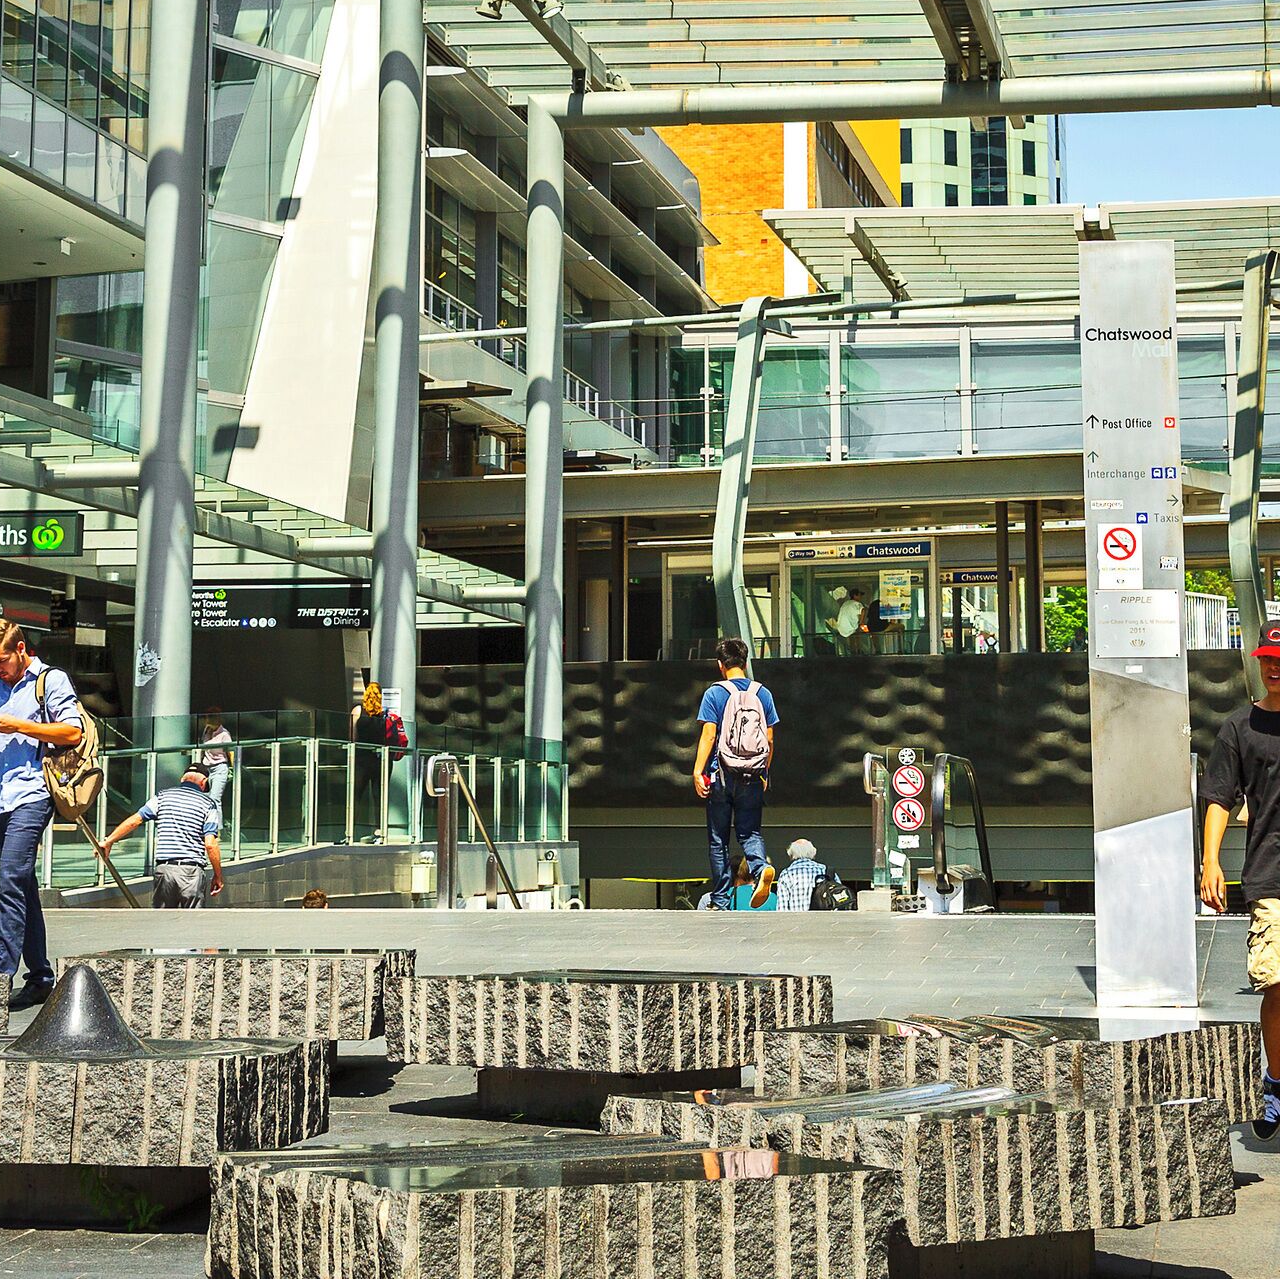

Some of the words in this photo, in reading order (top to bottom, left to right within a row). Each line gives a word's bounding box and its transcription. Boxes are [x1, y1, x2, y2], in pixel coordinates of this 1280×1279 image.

[1085, 326, 1173, 342] Chatswood
[1131, 341, 1173, 359] Mall
[1102, 418, 1122, 430] Post
[1125, 417, 1153, 429] Office
[1086, 467, 1146, 481] Interchange
[1153, 513, 1180, 523] Taxis
[866, 544, 921, 556] Chatswood
[202, 600, 228, 608] Tower
[1120, 596, 1152, 604] RIPPLE
[202, 609, 228, 617] Tower
[297, 608, 317, 617] THE
[317, 608, 361, 616] DISTRICT
[201, 618, 240, 627] Escalator
[333, 616, 361, 626] Dining
